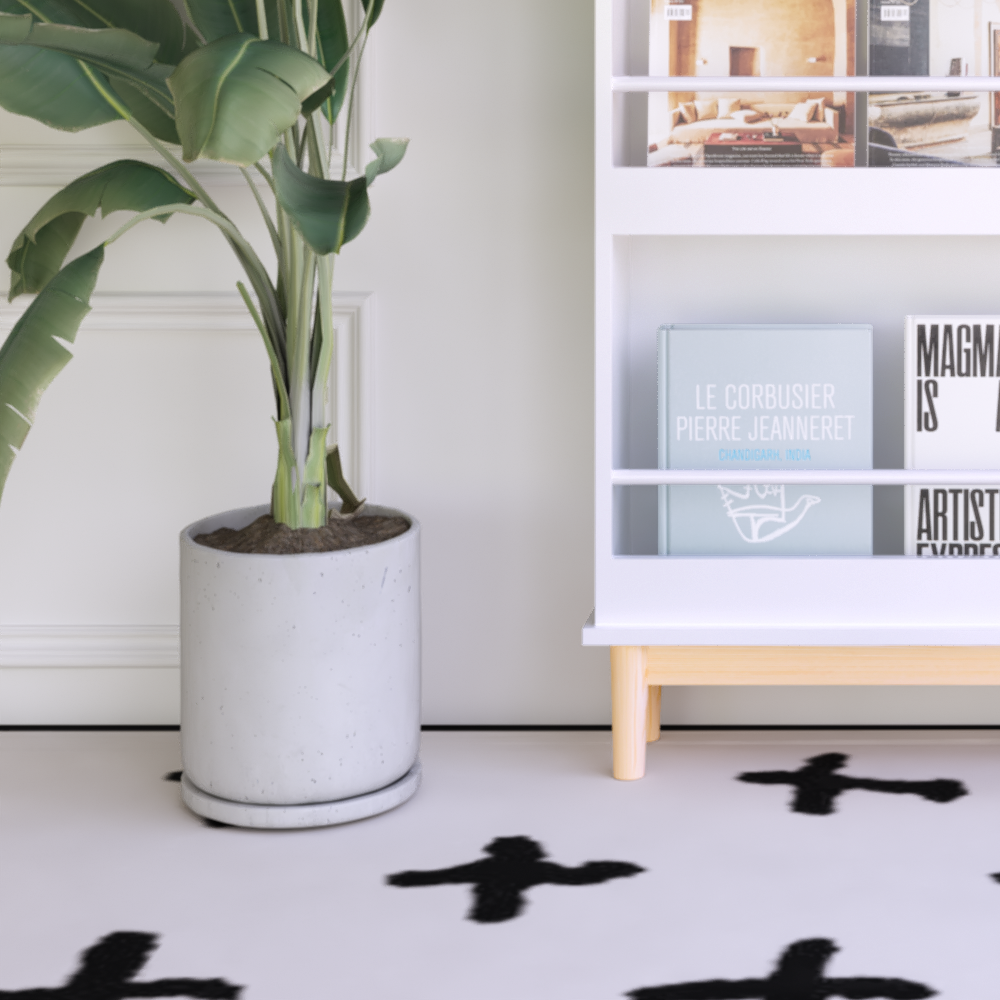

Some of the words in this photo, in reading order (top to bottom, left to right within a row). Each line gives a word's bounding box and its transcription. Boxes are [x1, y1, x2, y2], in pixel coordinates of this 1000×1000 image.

[696, 384, 716, 410] LE
[725, 384, 835, 409] CORBUSIER
[917, 380, 938, 432] IS
[676, 416, 741, 441] PIERRE
[748, 415, 855, 441] JEANNERET
[719, 449, 782, 461] CHANDIGARH,
[786, 449, 811, 461] INDIA
